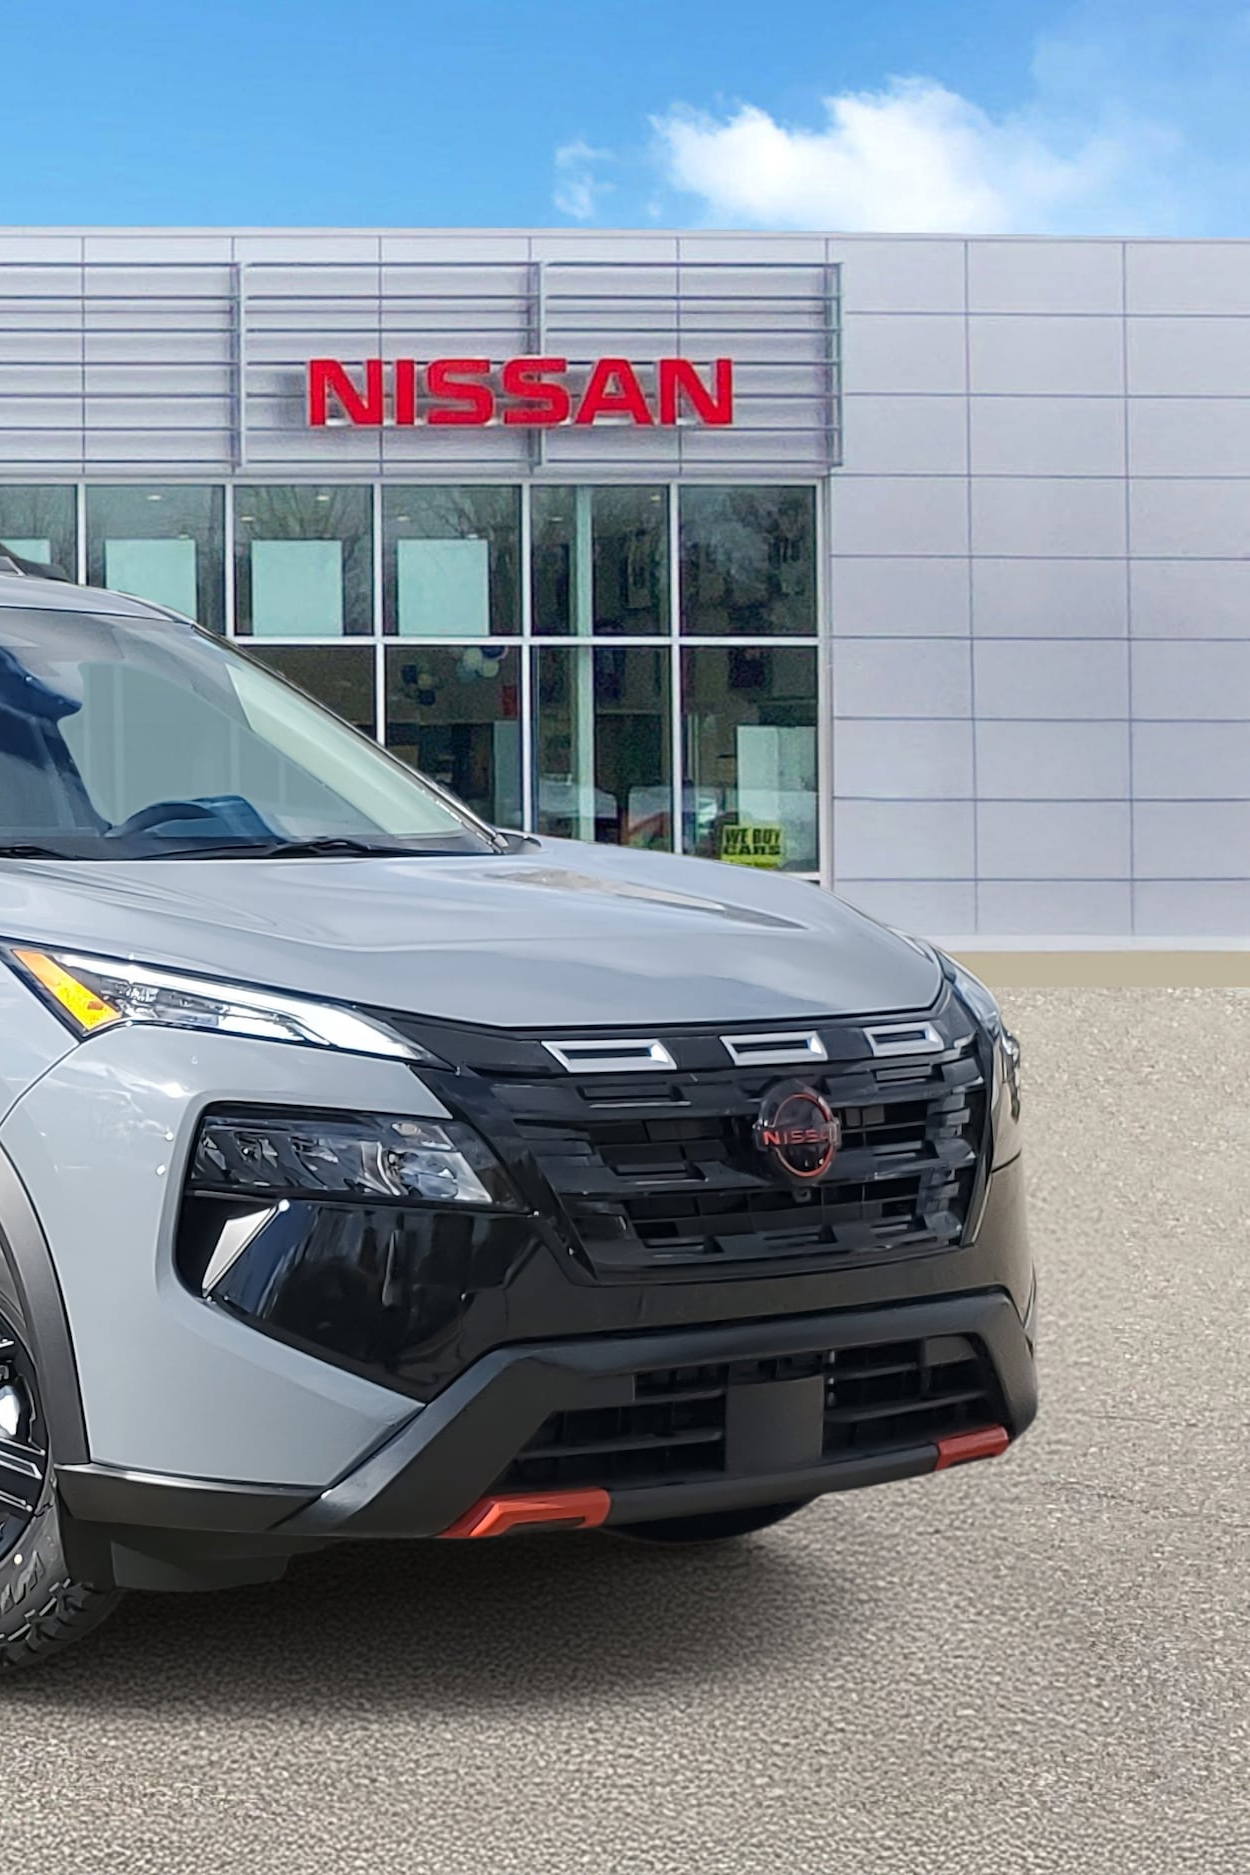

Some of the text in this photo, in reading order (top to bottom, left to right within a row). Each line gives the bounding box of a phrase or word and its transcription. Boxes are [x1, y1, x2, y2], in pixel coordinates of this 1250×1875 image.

[307, 358, 734, 427] NISSAN
[724, 828, 781, 845] WE BUY
[724, 845, 781, 856] CARS
